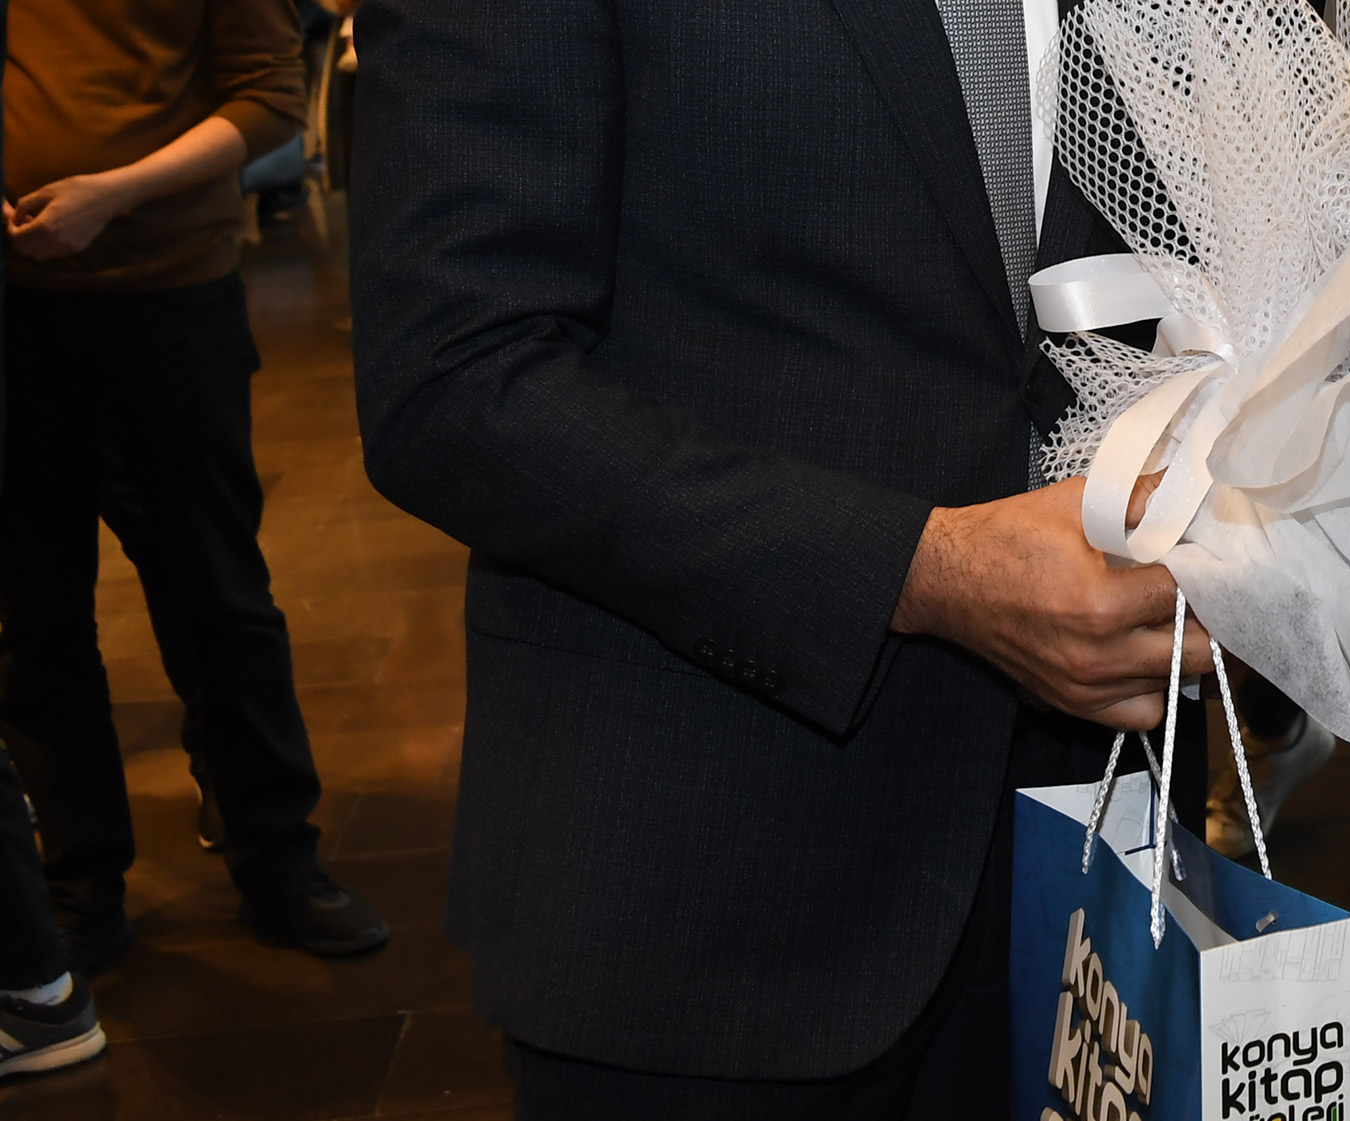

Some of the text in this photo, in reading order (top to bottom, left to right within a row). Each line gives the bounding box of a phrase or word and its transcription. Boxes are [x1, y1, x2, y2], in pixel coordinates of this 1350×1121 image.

[1062, 908, 1153, 1106] konya
[1221, 1021, 1344, 1075] konya
[1221, 1060, 1344, 1120] kitap
